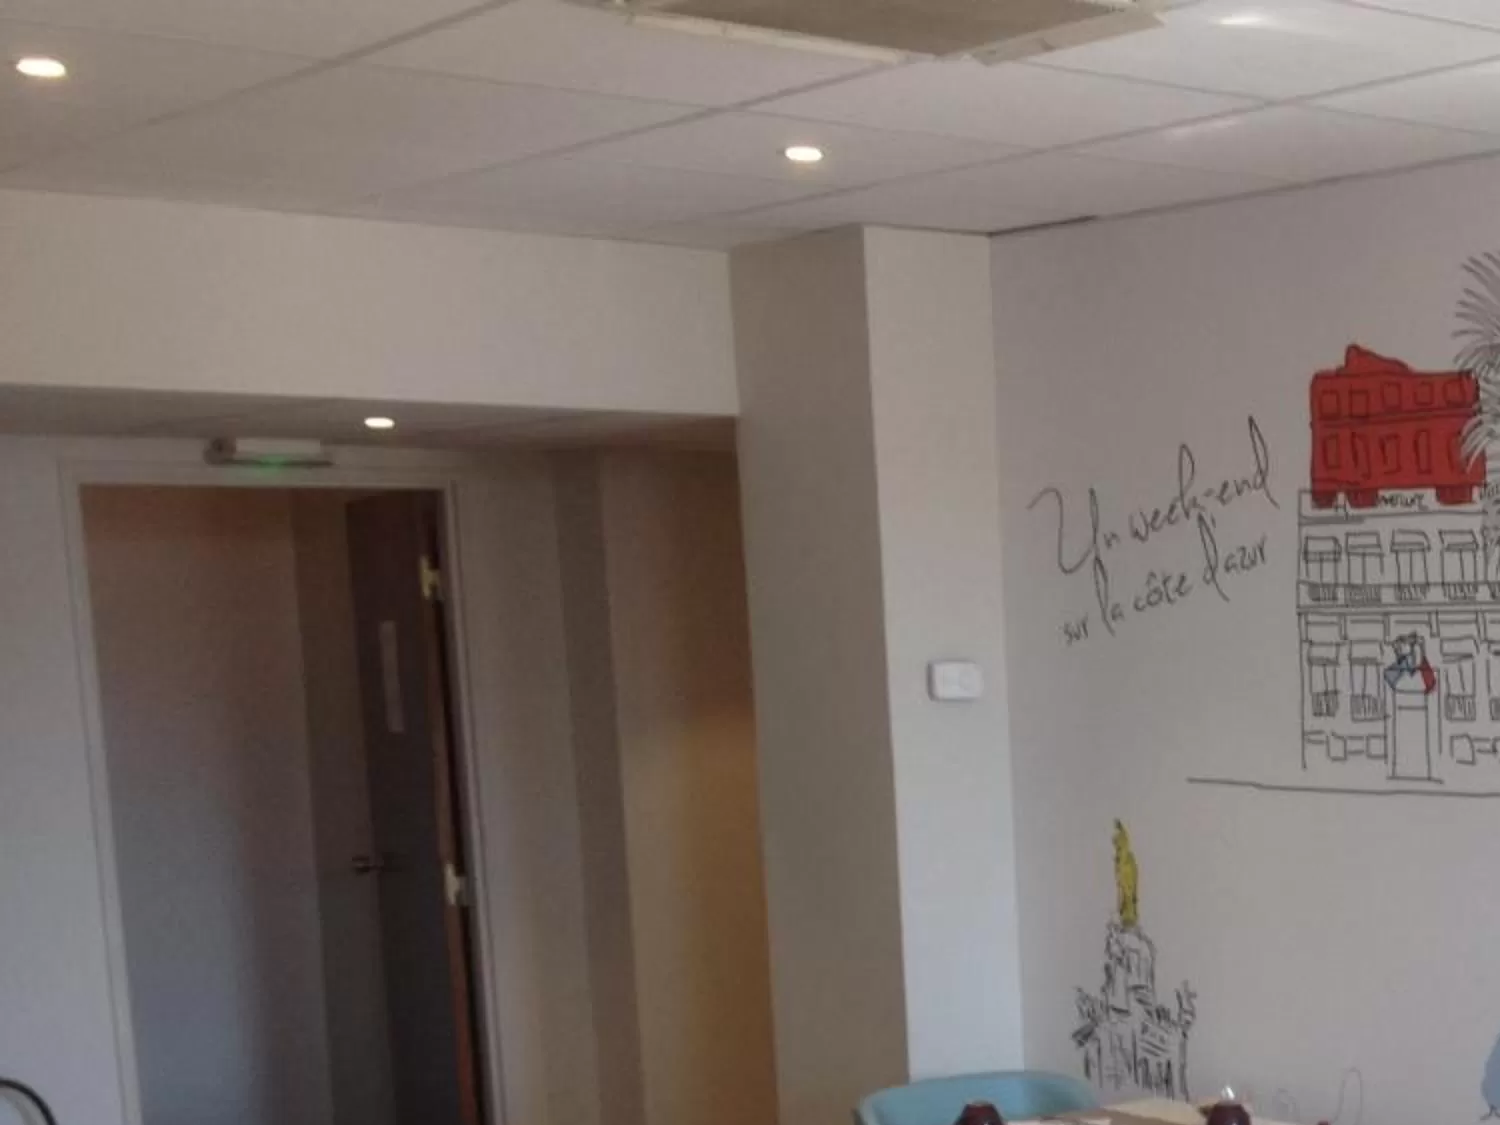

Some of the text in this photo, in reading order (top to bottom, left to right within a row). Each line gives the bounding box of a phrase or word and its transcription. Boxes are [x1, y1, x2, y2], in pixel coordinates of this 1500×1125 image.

[1026, 486, 1121, 575] Un
[1063, 615, 1089, 645] sur
[1094, 555, 1124, 637] la
[1132, 570, 1194, 612] côte
